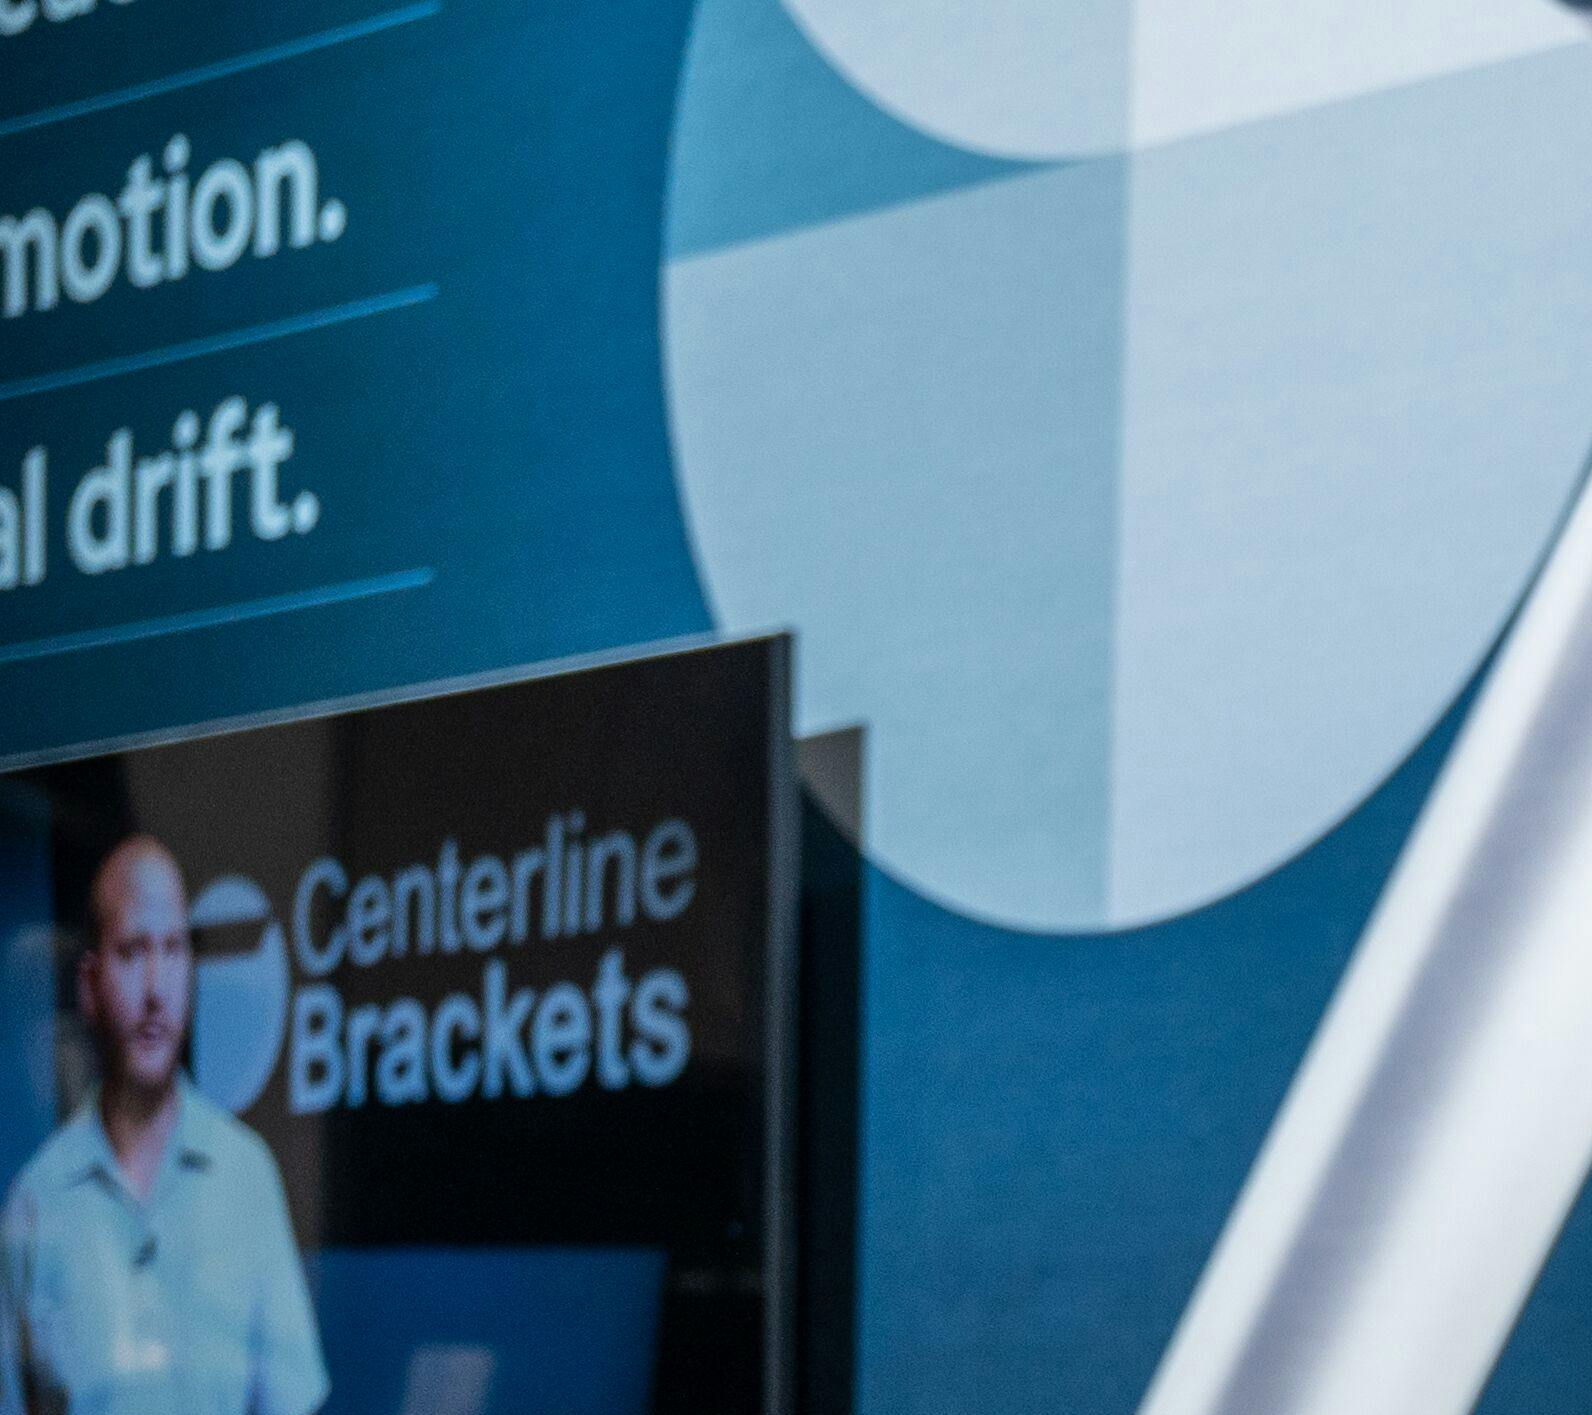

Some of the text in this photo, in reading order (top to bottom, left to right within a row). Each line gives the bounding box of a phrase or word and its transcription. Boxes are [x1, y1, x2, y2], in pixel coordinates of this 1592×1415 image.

[0, 133, 346, 318] motion.
[67, 395, 320, 575] drift.
[294, 809, 699, 976] Centerline
[290, 947, 693, 1114] Brackets
